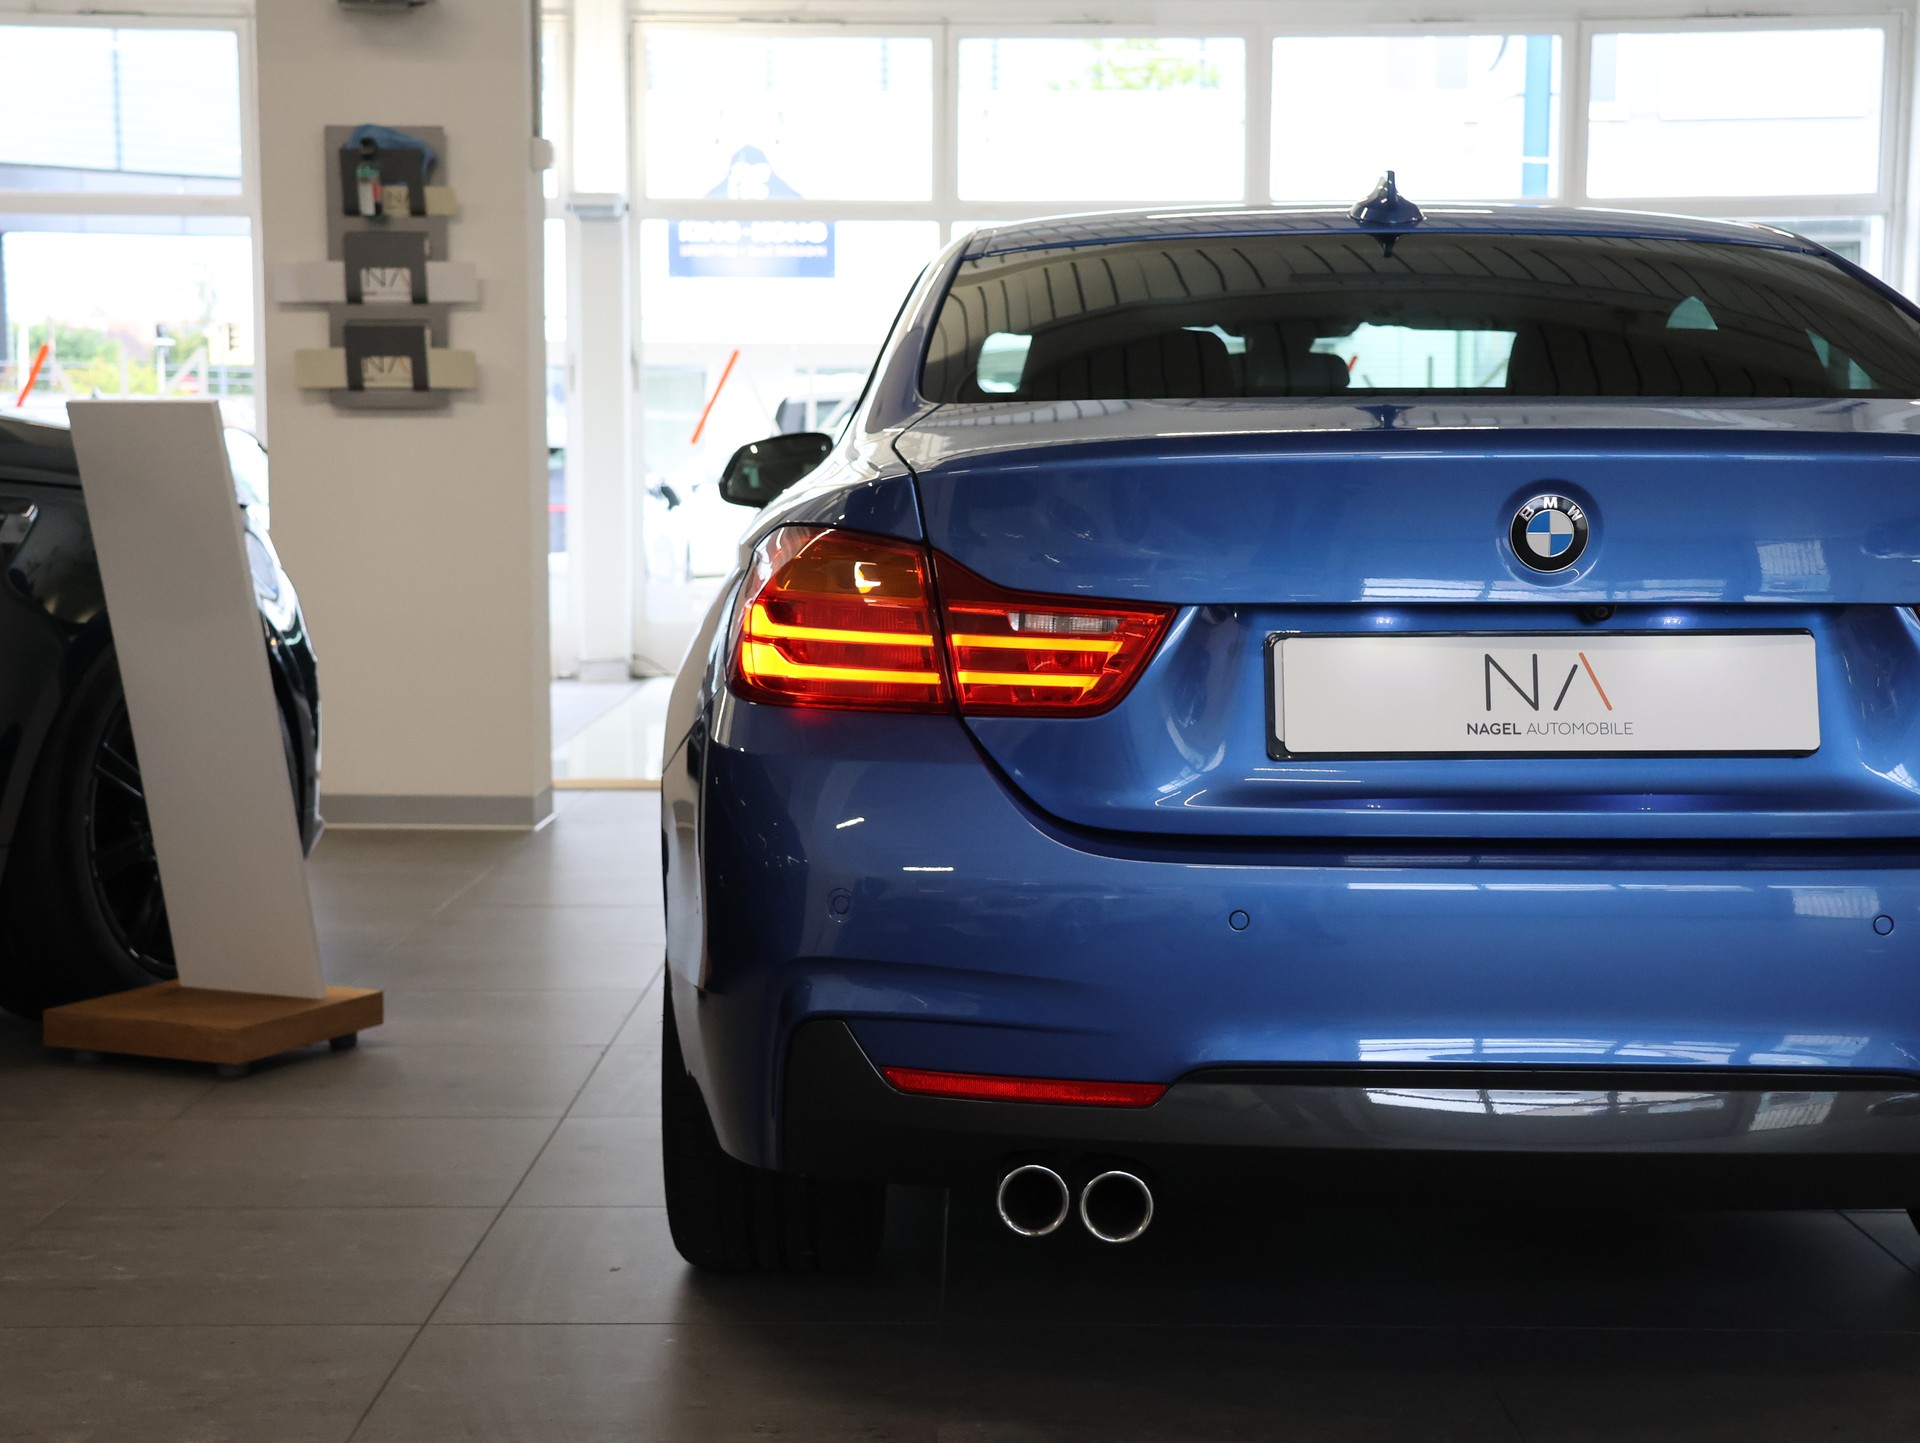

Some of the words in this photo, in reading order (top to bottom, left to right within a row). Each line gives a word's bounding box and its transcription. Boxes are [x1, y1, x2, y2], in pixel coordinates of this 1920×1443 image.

[1519, 496, 1582, 521] BMW
[1485, 652, 1612, 711] NA
[1467, 722, 1522, 735] NAGEL
[1526, 722, 1634, 735] AUTOMOBILE
